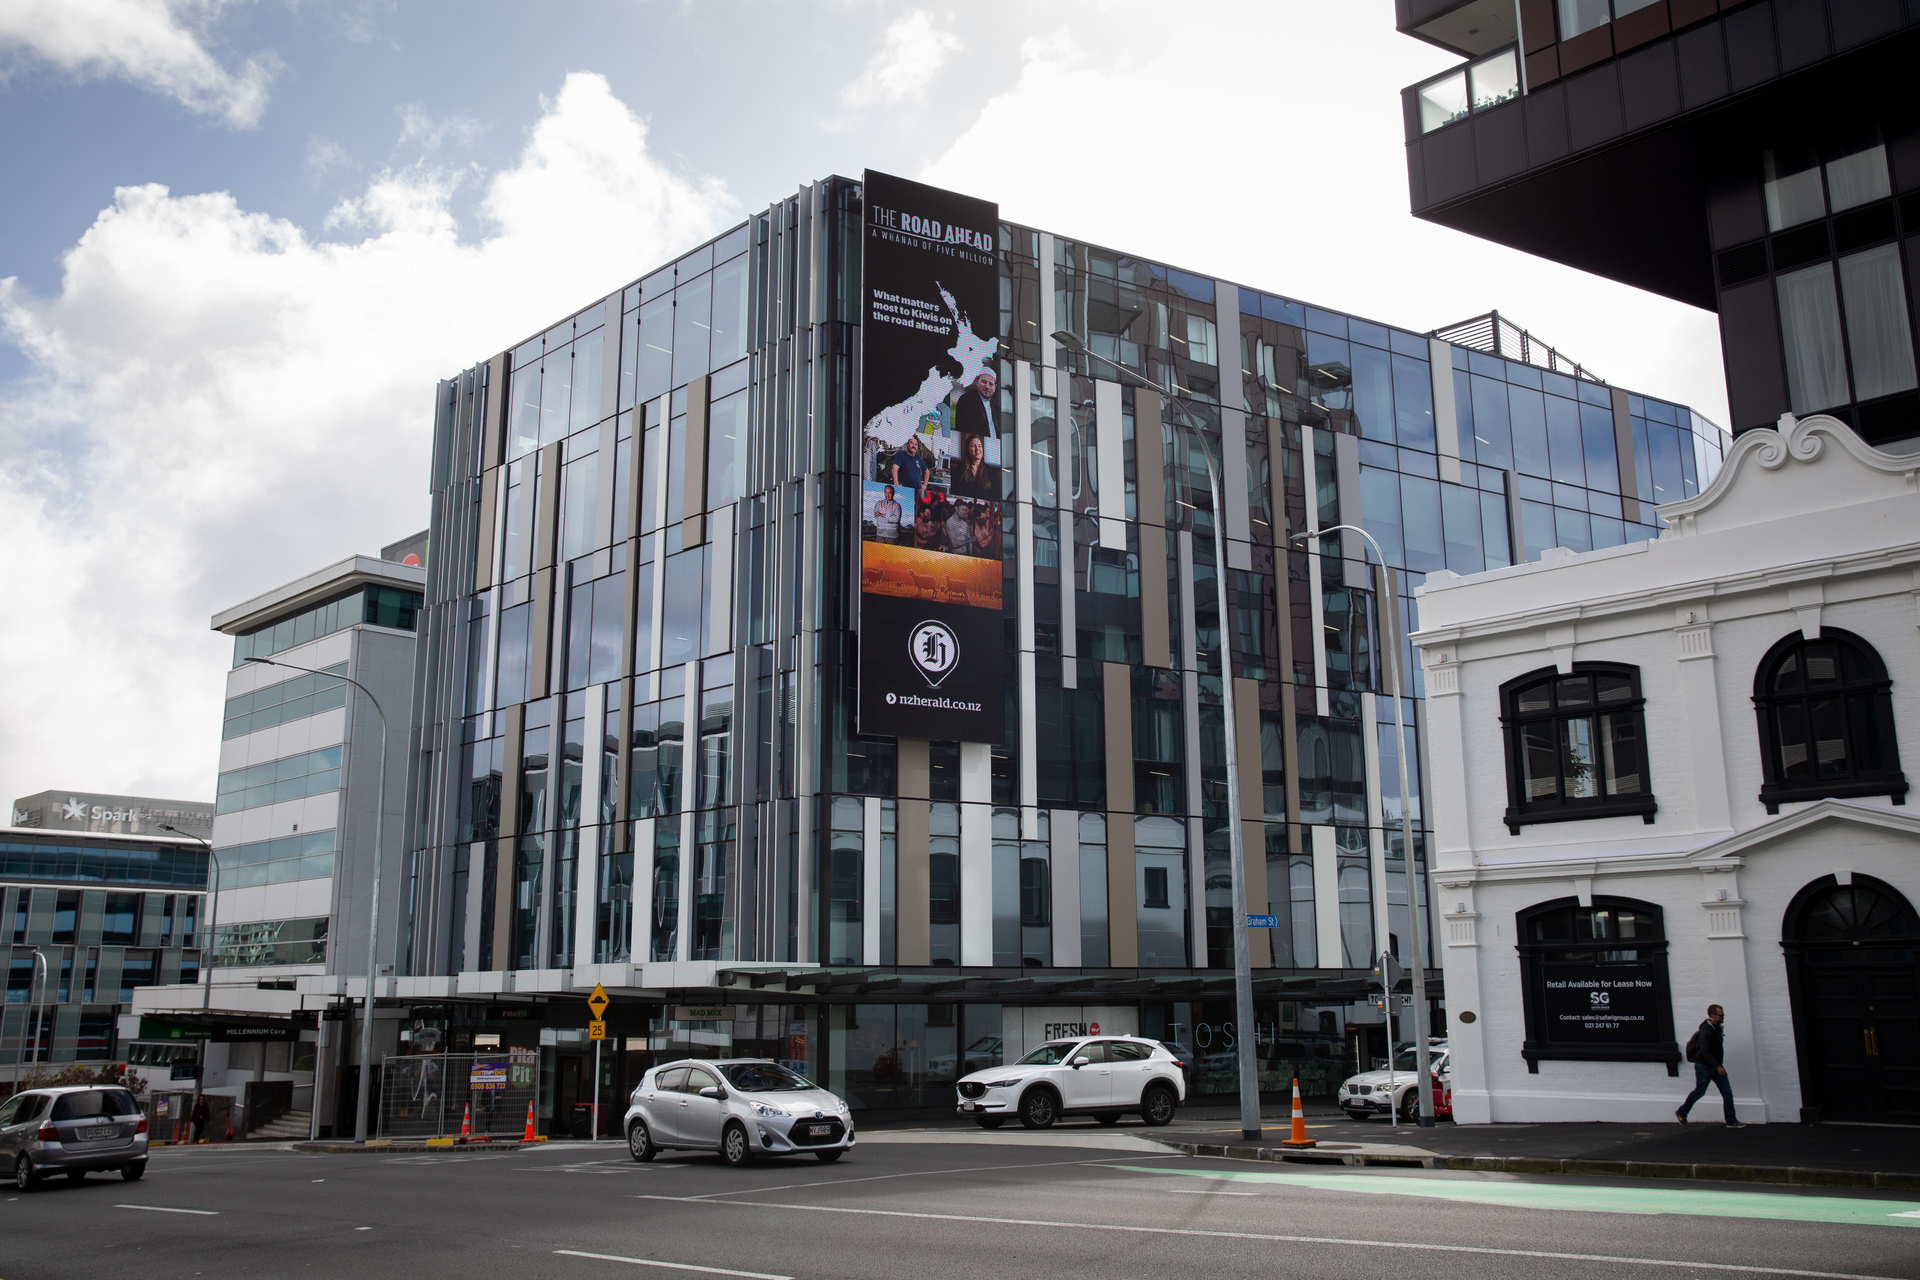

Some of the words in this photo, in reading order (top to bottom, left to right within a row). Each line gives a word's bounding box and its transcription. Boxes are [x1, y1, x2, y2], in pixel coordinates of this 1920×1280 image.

[873, 205, 897, 228] THE
[901, 212, 941, 239] ROAD
[945, 224, 993, 252] AHEAD
[872, 229, 877, 237] A
[922, 241, 932, 251] OF
[936, 244, 955, 257] FIVE
[959, 250, 993, 266] MILLION
[873, 289, 900, 303] What
[901, 296, 940, 312] matters
[873, 301, 898, 314] most
[900, 306, 910, 316] to
[911, 309, 938, 323] Kiwis
[939, 316, 953, 326] on
[873, 311, 890, 322] the
[891, 316, 914, 328] road
[915, 321, 951, 335] ahead?
[899, 695, 982, 712] nzherald.co.nz
[91, 806, 138, 822] Spark
[1247, 916, 1267, 926] Graham
[1268, 916, 1275, 926] St
[1568, 980, 1600, 988] Available
[1601, 980, 1612, 988] for
[1613, 980, 1634, 988] Lease
[1590, 991, 1610, 1004] SG
[689, 1009, 706, 1017] MAD
[270, 1028, 286, 1036] Corp
[592, 1025, 603, 1036] 25
[510, 1046, 535, 1064] Pita
[512, 1065, 531, 1083] Pit
